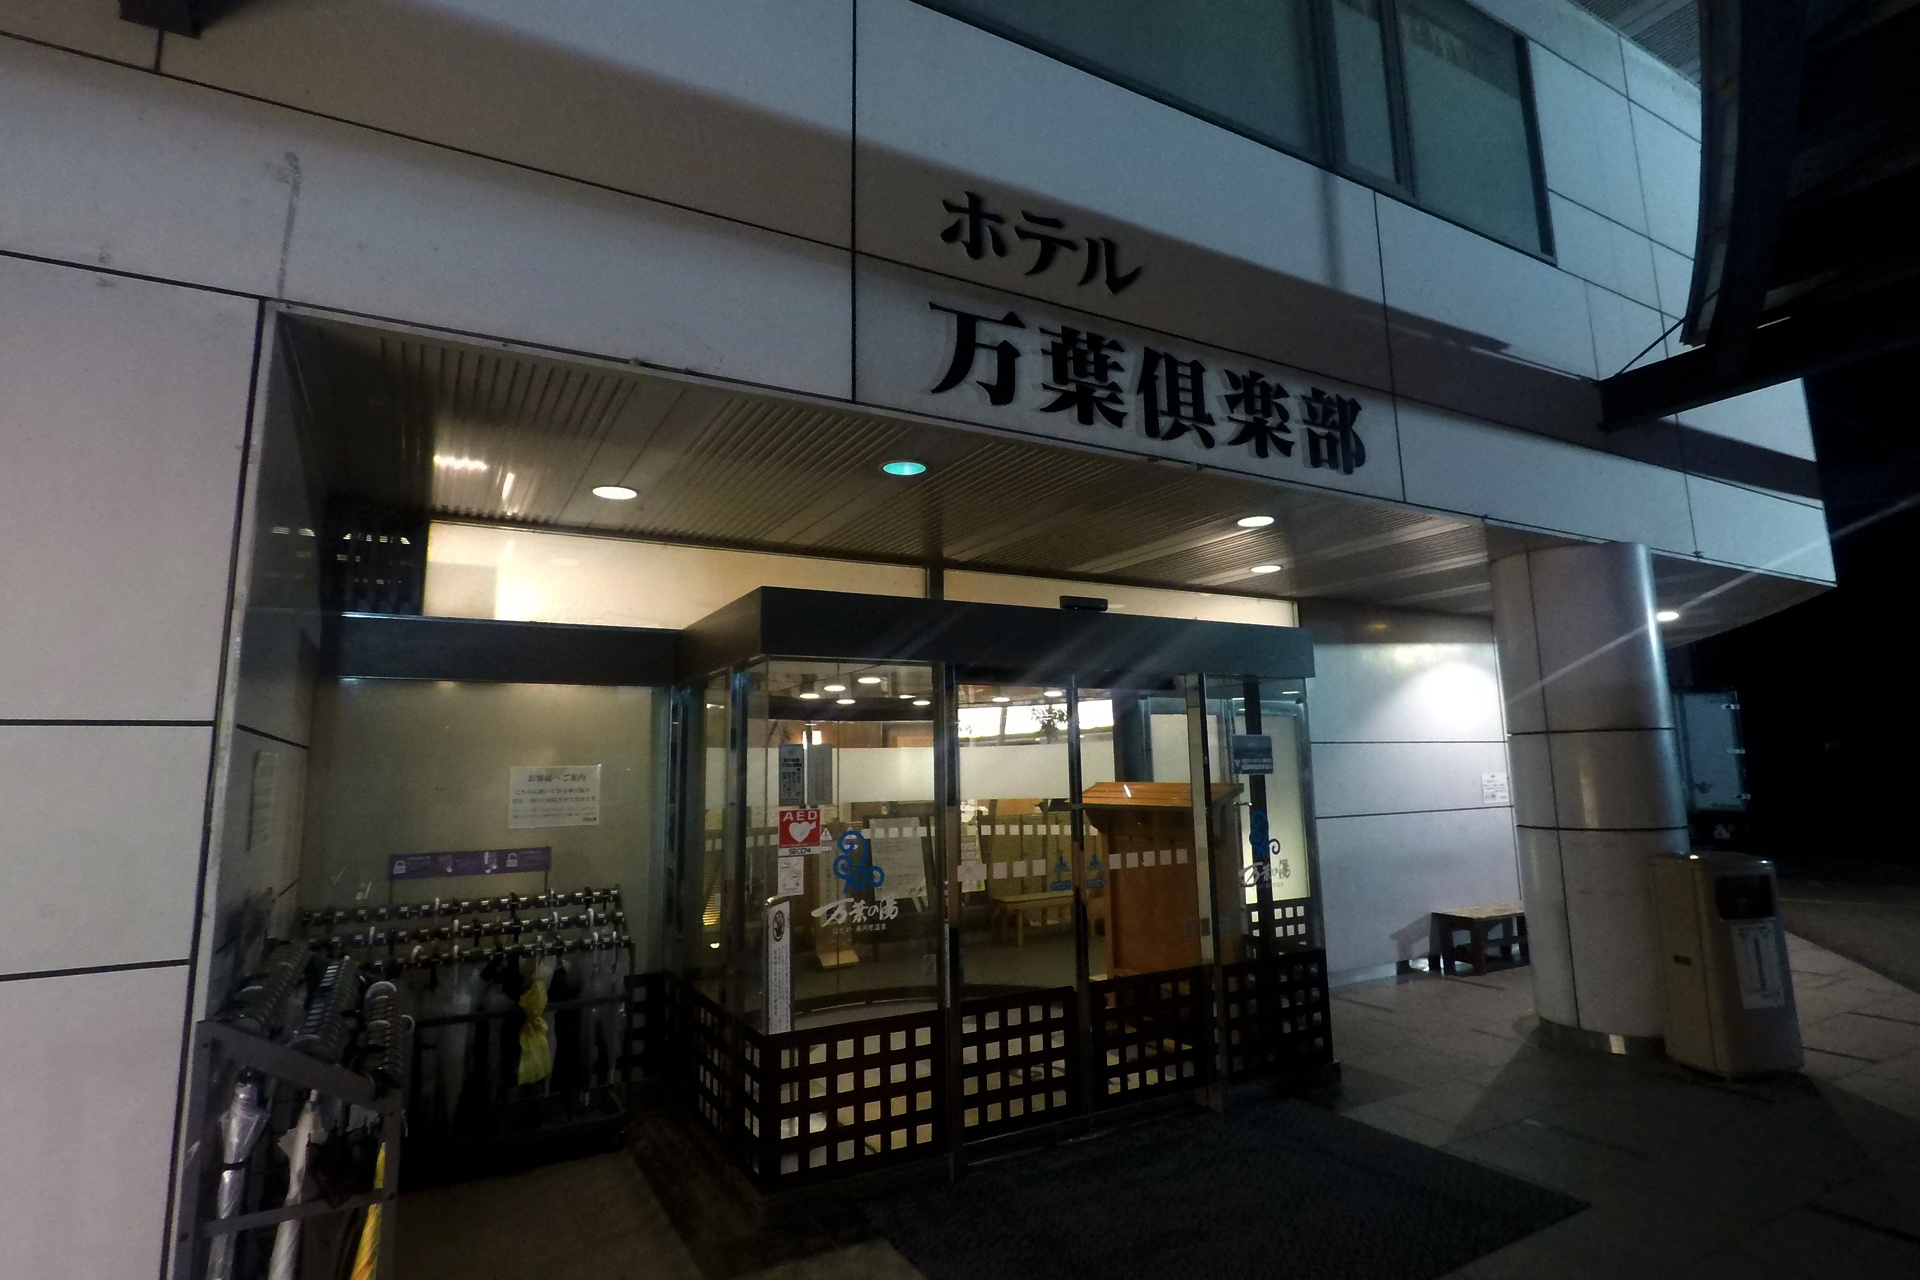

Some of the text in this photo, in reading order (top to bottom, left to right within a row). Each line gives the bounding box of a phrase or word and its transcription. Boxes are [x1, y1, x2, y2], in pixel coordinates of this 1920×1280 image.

[940, 191, 1143, 294] ホテル
[783, 811, 818, 821] AED
[811, 893, 899, 928] 万葉の湯
